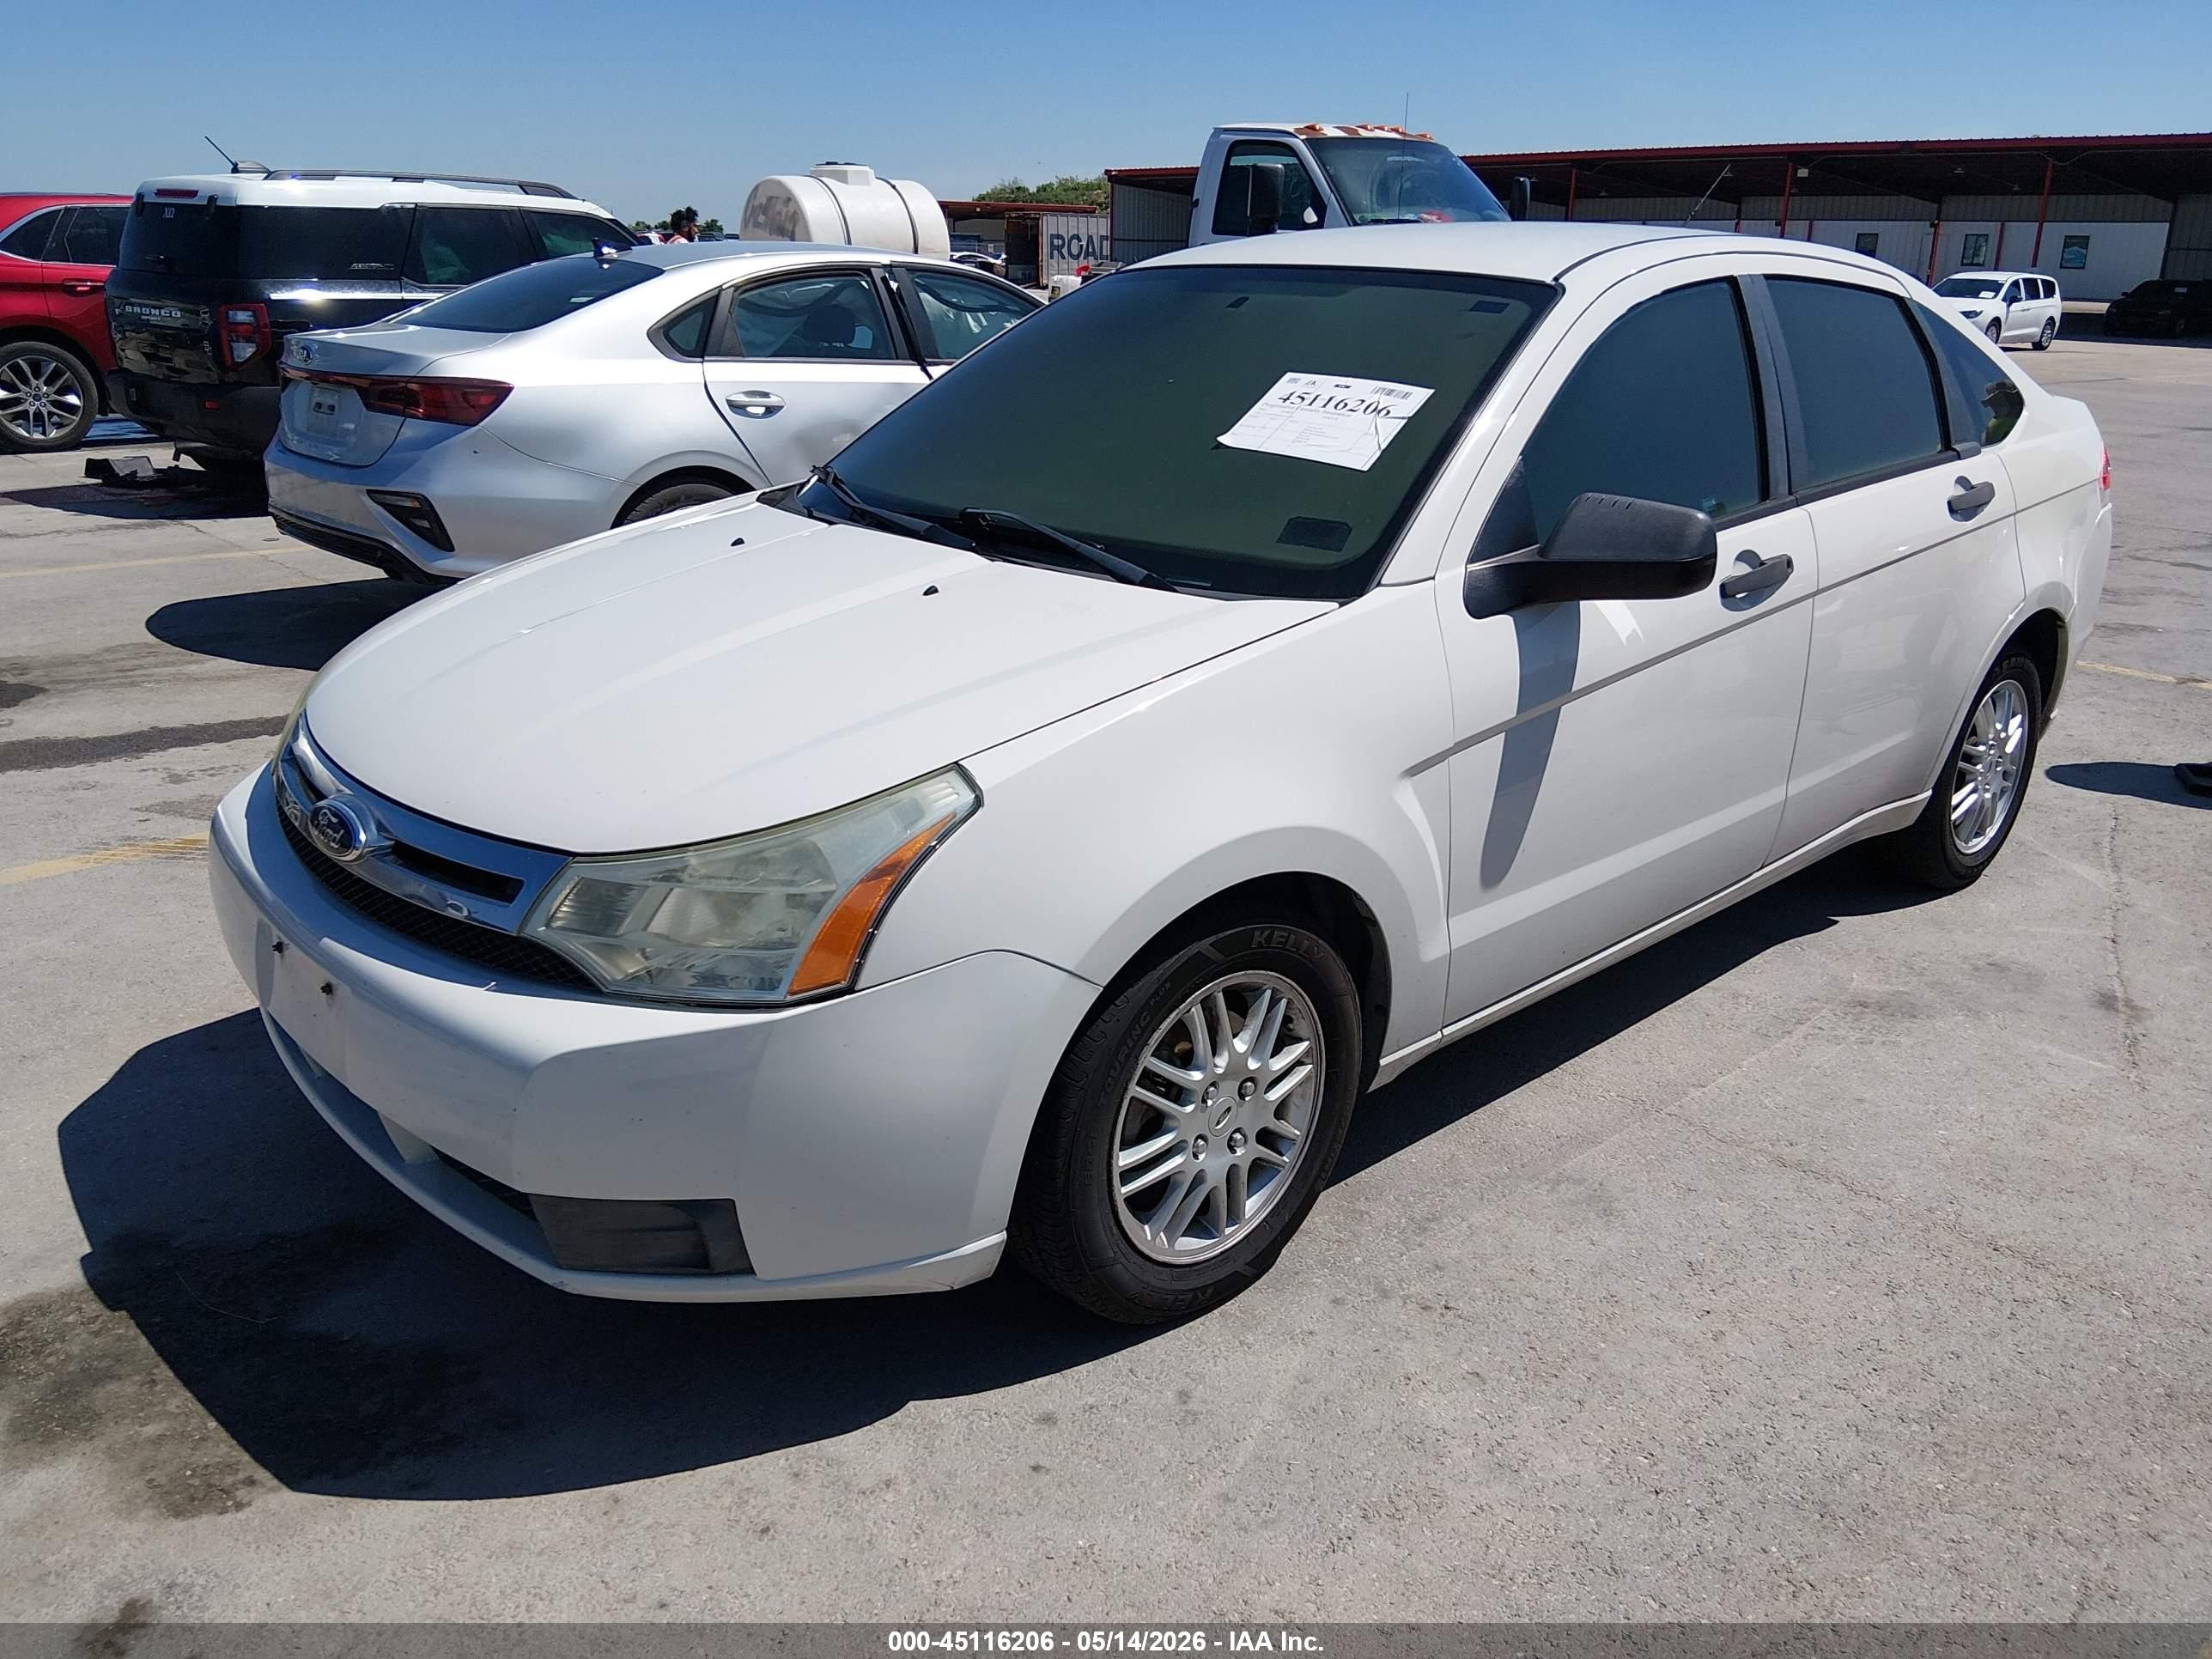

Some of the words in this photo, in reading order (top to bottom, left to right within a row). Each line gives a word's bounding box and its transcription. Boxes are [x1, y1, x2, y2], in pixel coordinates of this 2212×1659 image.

[125, 305, 181, 318] BRONCO
[1277, 391, 1398, 418] 45116206
[313, 809, 345, 848] Ford
[1250, 928, 1327, 962] KELLY
